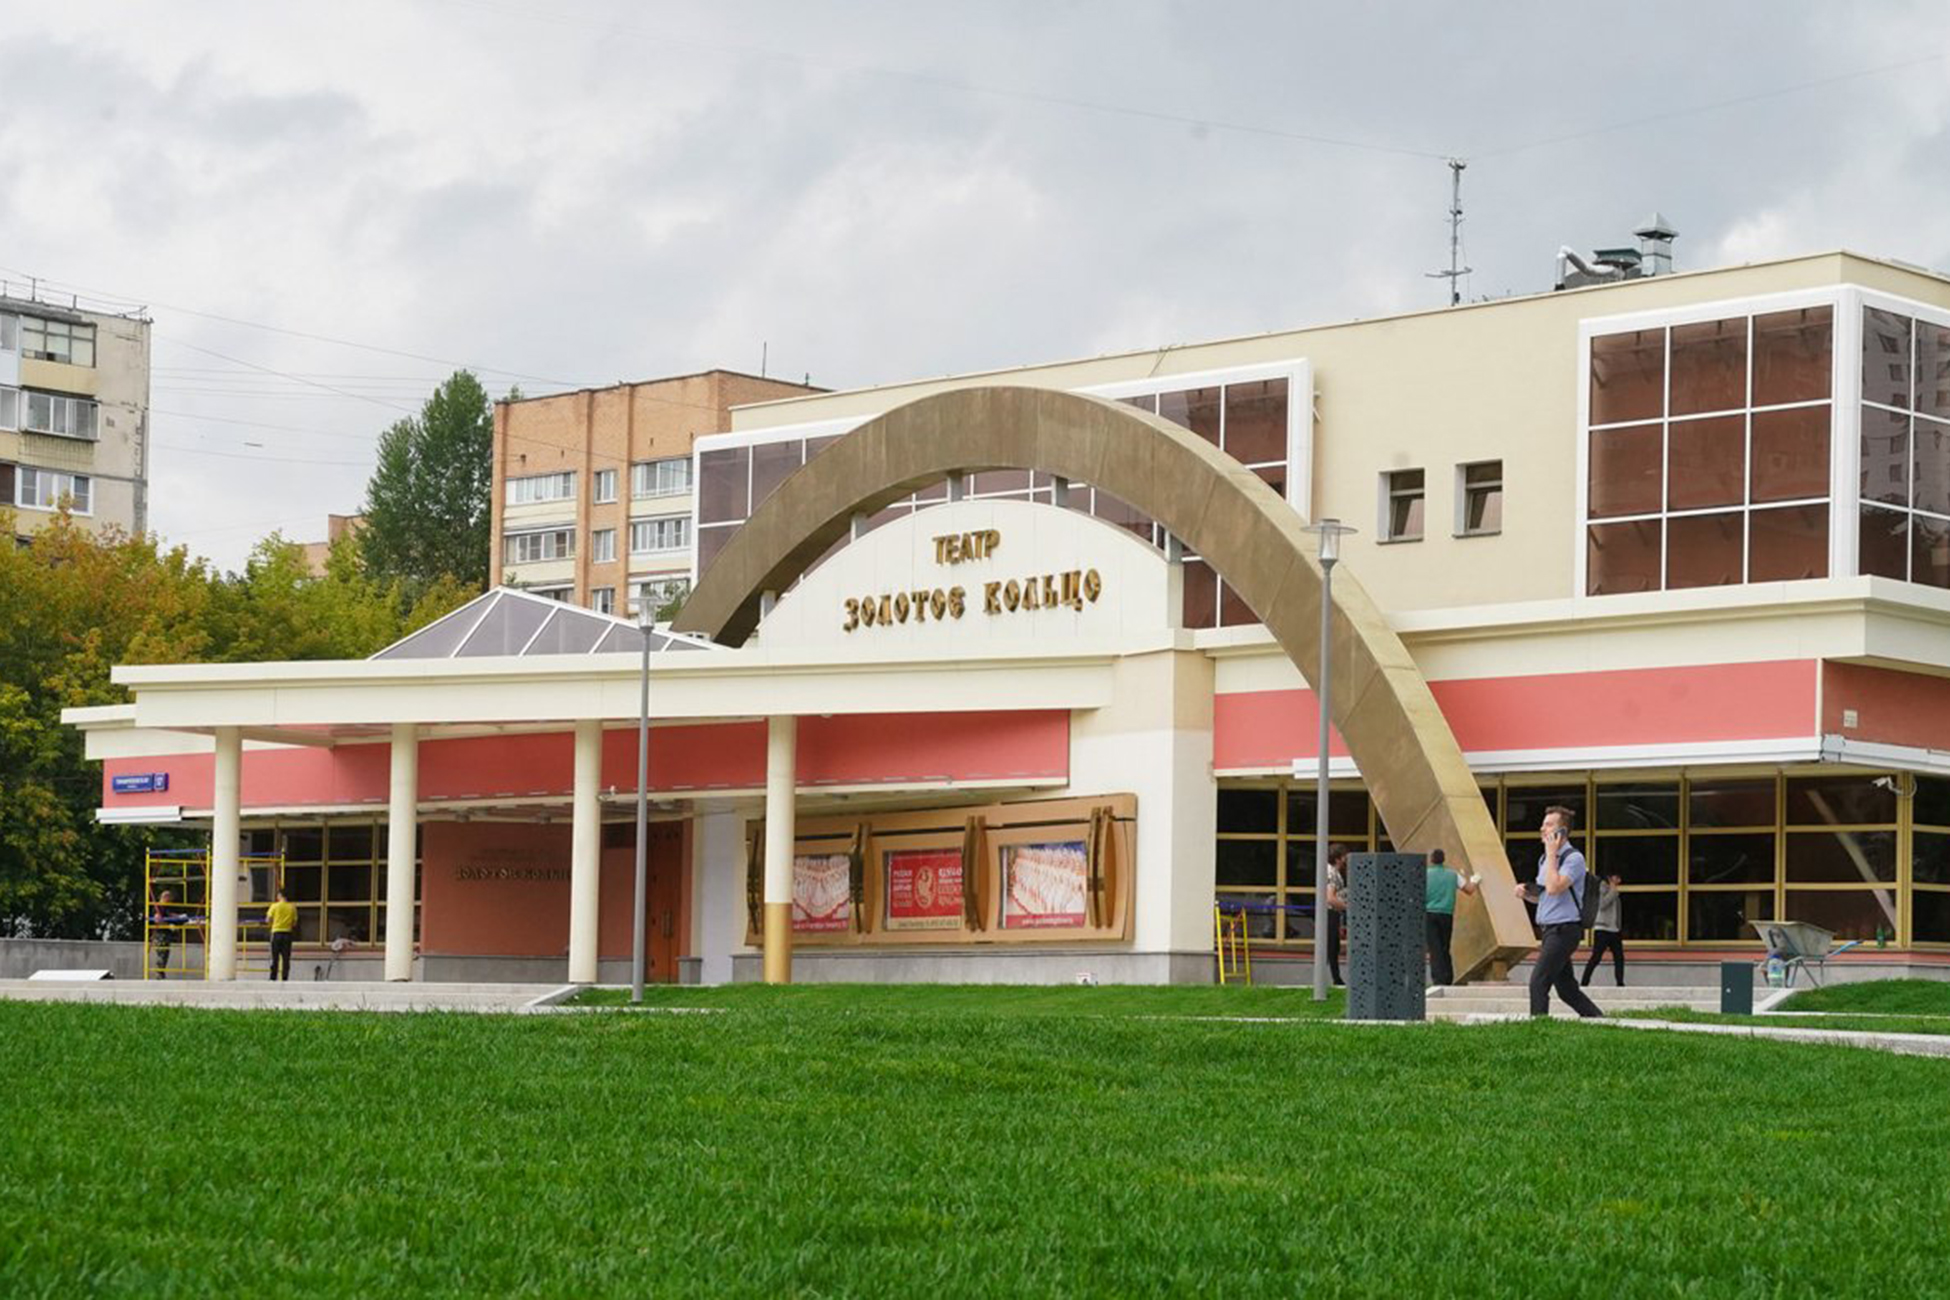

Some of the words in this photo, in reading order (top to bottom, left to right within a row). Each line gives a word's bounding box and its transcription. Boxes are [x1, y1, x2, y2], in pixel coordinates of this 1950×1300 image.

[932, 529, 1000, 565] ТЕАТР
[843, 585, 965, 632] ЗОЛОТОЕ
[983, 568, 1101, 615] КОЛЬЦО
